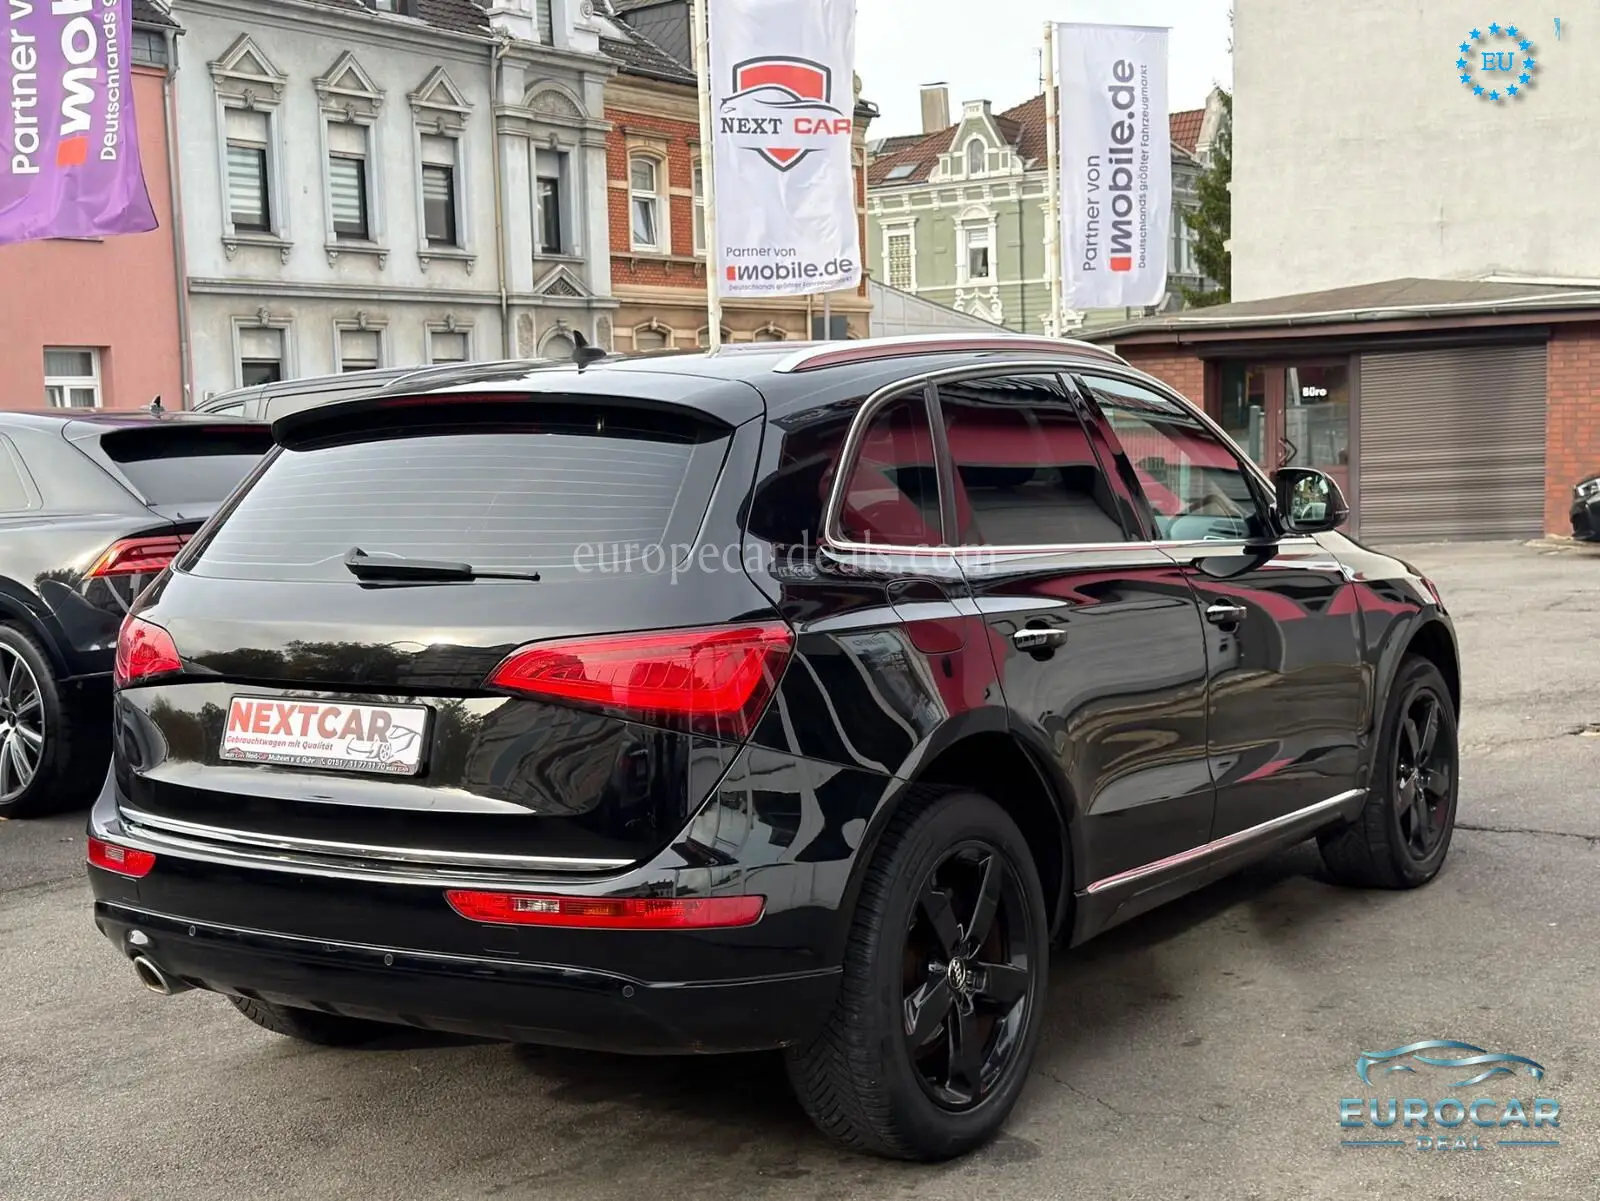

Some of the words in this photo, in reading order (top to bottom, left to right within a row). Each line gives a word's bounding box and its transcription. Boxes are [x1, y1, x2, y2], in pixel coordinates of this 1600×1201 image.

[10, 29, 39, 173] Partner
[100, 12, 119, 160] Deutschlands
[721, 118, 782, 134] NEXT
[793, 118, 851, 135] CAR
[1087, 155, 1100, 192] von
[1108, 59, 1135, 253] mobile.de
[1083, 197, 1100, 271] Partner
[1138, 193, 1147, 268] Deutschlands
[726, 247, 771, 257] Partner
[774, 248, 796, 257] von
[738, 258, 853, 280] mobile.de
[1302, 386, 1327, 397] Büro
[226, 736, 286, 748] Gebrauchtwagen
[288, 739, 301, 748] mit
[228, 702, 393, 743] NEXTCAR
